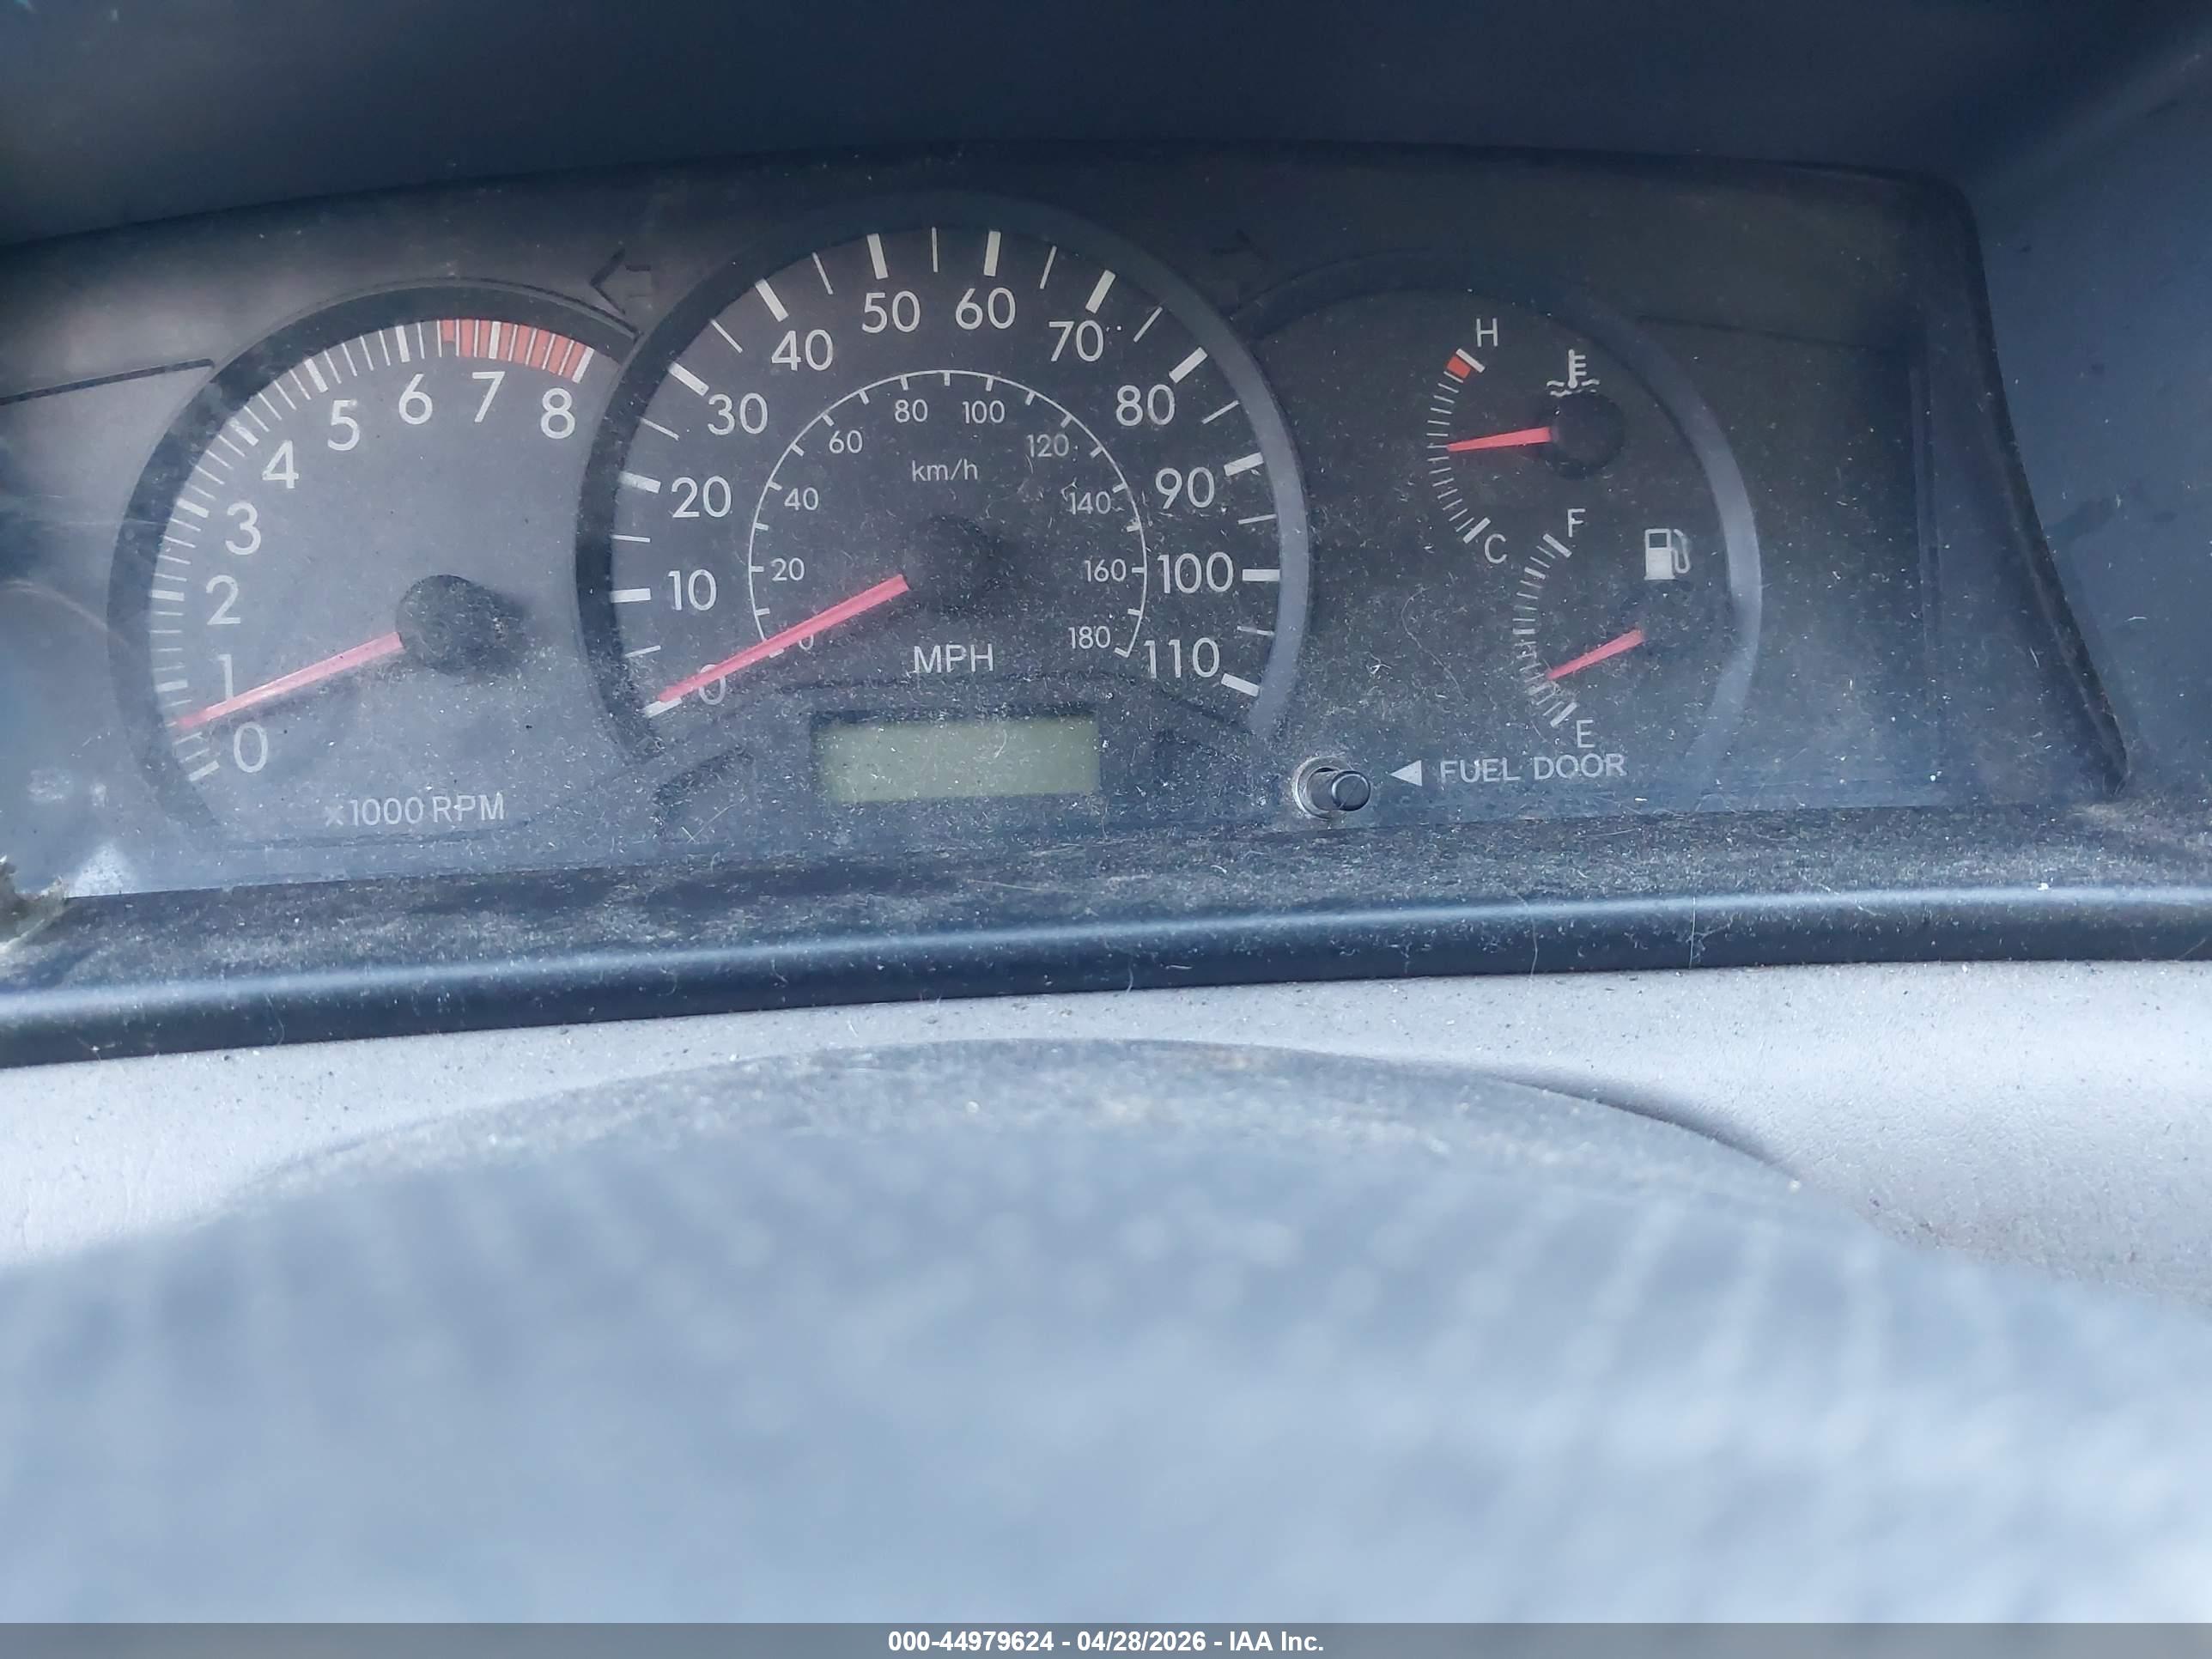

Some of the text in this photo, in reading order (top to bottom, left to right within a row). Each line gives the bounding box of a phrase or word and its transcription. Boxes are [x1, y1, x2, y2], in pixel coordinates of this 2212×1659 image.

[861, 290, 921, 333] 50
[954, 287, 1017, 331] 60
[771, 329, 834, 371] 40
[1048, 319, 1104, 362] 70
[1476, 318, 1498, 347] H
[398, 374, 433, 425] 6
[471, 371, 506, 422] 7
[540, 388, 575, 439] 8
[707, 392, 769, 435] 30
[894, 398, 928, 422] 80
[962, 399, 1006, 424] 100
[1115, 383, 1176, 427] 80
[327, 399, 360, 451] 5
[829, 429, 863, 454] 60
[1027, 433, 1070, 458] 120
[262, 441, 299, 489] 4
[912, 459, 979, 482] km/h
[671, 475, 732, 519] 20
[784, 487, 819, 511] 40
[1067, 489, 1112, 514] 140
[1155, 465, 1215, 509] 90
[226, 501, 261, 556] 3
[1567, 508, 1586, 538] F
[771, 557, 805, 581] 20
[1485, 533, 1507, 563] C
[667, 568, 717, 611] 10
[1085, 557, 1127, 583] 160
[1158, 550, 1234, 594] 100
[205, 574, 241, 625] 2
[914, 643, 994, 674] MPH
[1067, 625, 1111, 650] 180
[1144, 636, 1220, 679] 110
[216, 653, 234, 700] 1
[233, 721, 269, 773] 0
[1577, 720, 1595, 749] E
[1440, 752, 1627, 783] FUEL DOOR
[432, 792, 505, 823] RPM
